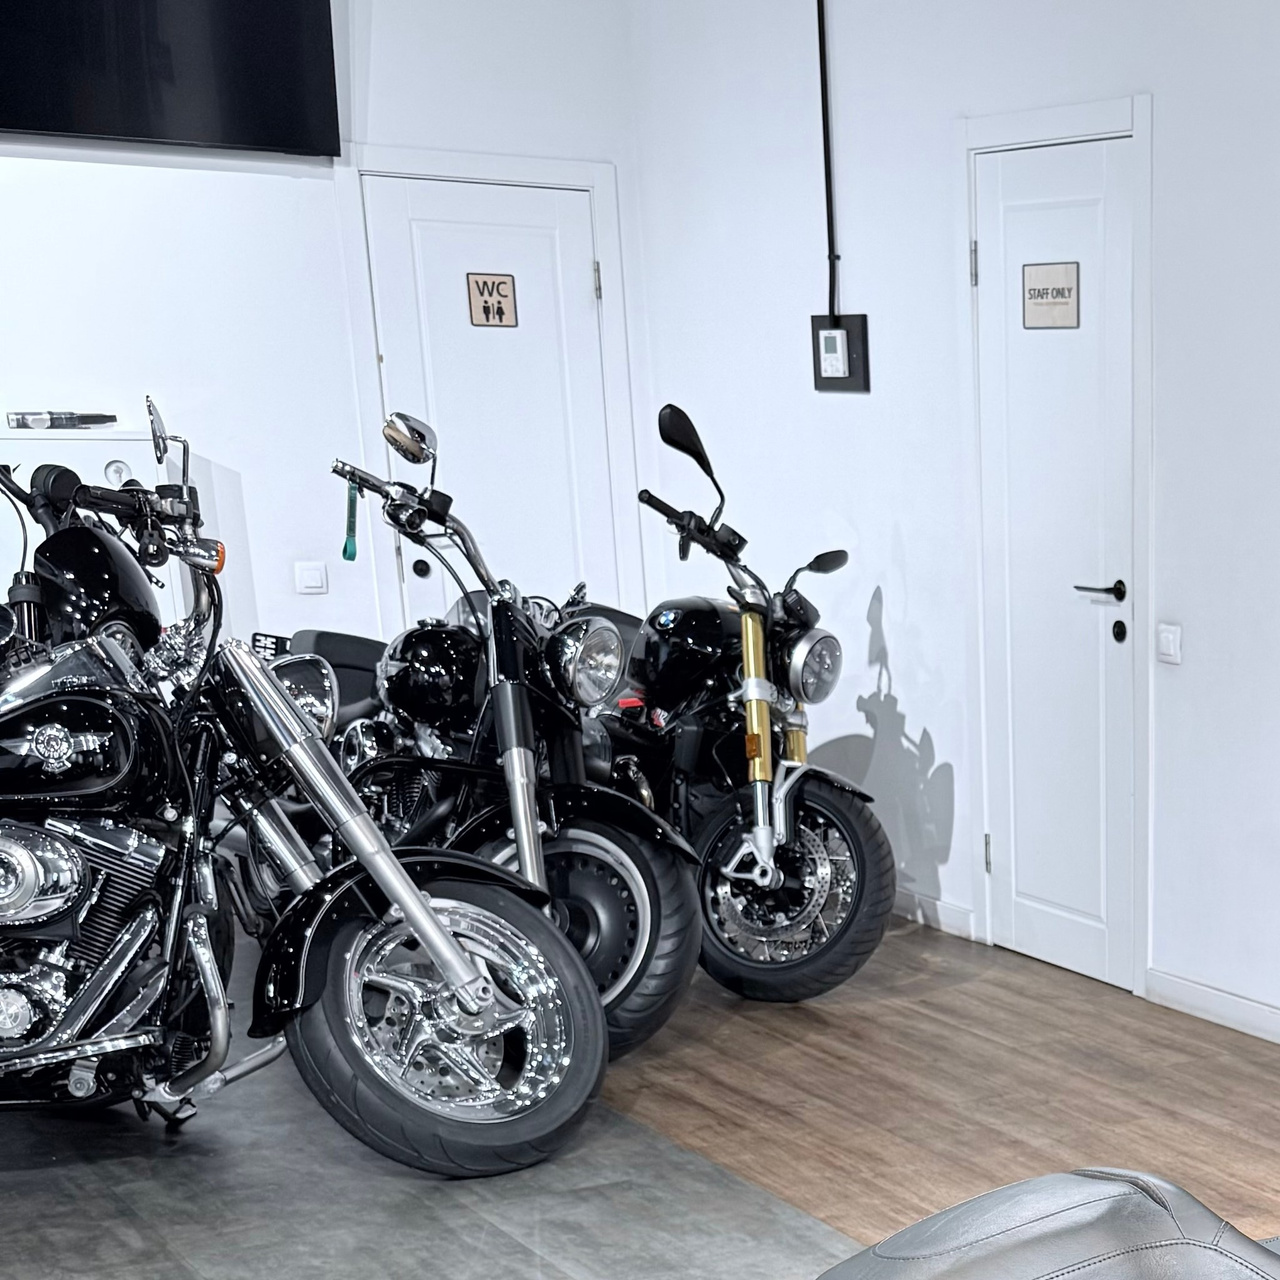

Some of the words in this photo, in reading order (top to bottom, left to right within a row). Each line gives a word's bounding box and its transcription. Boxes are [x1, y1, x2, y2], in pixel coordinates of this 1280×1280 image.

[475, 280, 508, 298] WC
[1028, 288, 1050, 300] STAFF
[1051, 287, 1073, 299] ONLY
